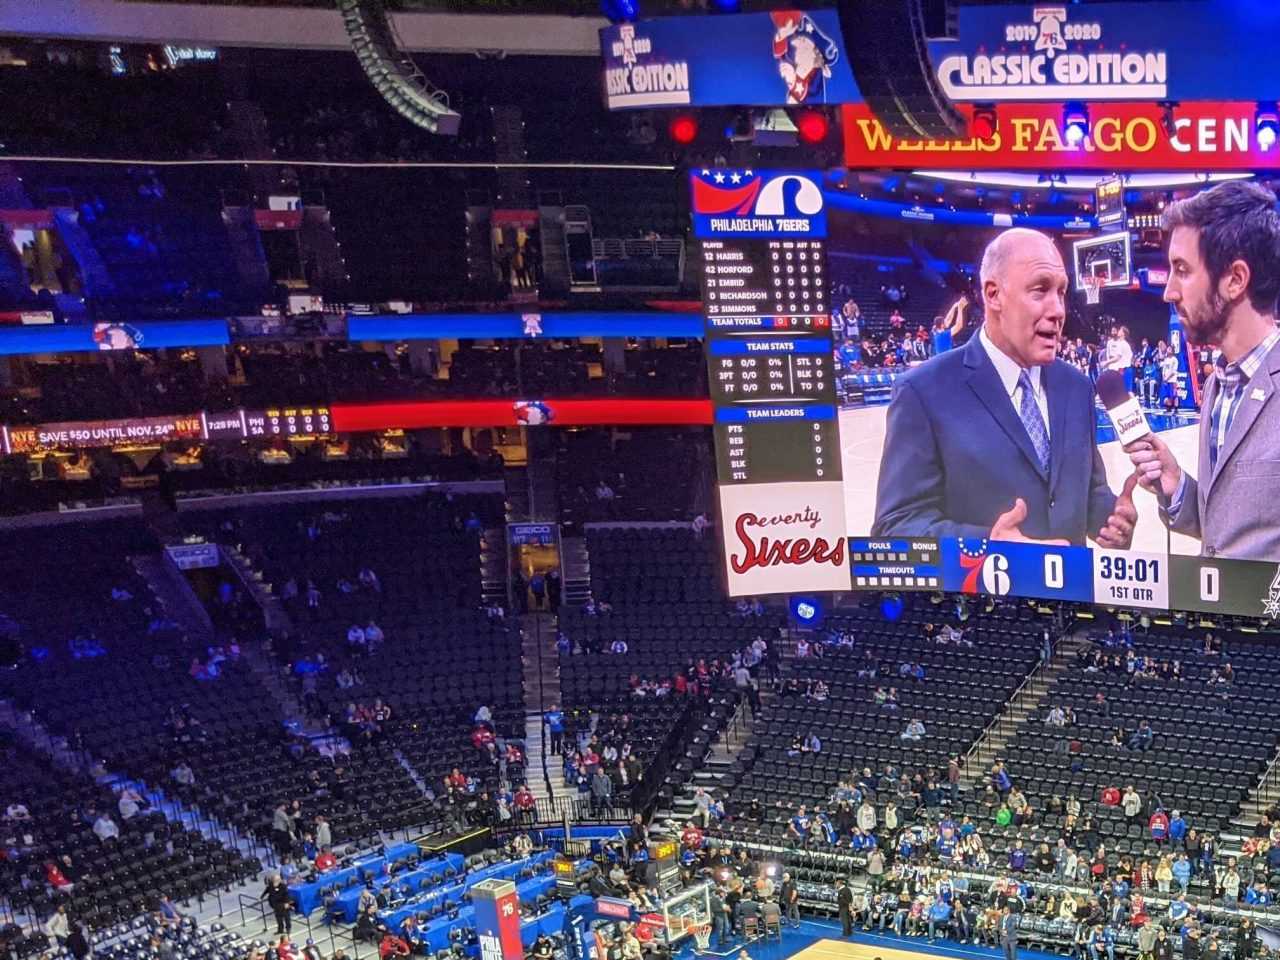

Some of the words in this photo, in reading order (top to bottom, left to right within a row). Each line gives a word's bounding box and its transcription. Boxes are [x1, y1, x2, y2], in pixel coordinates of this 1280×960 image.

[1006, 25, 1038, 41] 2019
[1065, 24, 1101, 40] 2020
[1042, 32, 1058, 45] 76
[938, 54, 1047, 88] CLASSIC
[1053, 52, 1168, 85] EDITION
[632, 62, 689, 92] EDITION
[711, 219, 774, 232] PHILADELPHIA
[776, 219, 810, 232] 76ERS
[704, 253, 714, 261] 12
[716, 252, 744, 261] HARRIS
[706, 266, 716, 274] 42
[717, 266, 753, 274] HORFORD
[707, 279, 716, 287] 21
[720, 292, 767, 300] RICHARDSON
[709, 305, 719, 313] 25
[721, 305, 757, 313] SIMMONS
[712, 318, 734, 326] TEAM
[746, 343, 770, 351] TEAM
[770, 342, 794, 350] STATS
[722, 360, 733, 368] FG
[741, 359, 756, 367] 0/0
[768, 358, 782, 367] 0%
[797, 358, 811, 366] STL
[719, 372, 735, 380] 3PT
[742, 371, 757, 380] 0/0
[769, 370, 782, 379] 0%
[797, 370, 812, 378] BLK
[742, 383, 758, 392] 0/0
[770, 383, 784, 391] 0%
[801, 382, 812, 390] TO
[747, 410, 770, 418] TEAM
[770, 409, 805, 417] LEADERS
[249, 417, 264, 427] PHI
[10, 430, 35, 444] NYE
[39, 431, 69, 443] SAVE
[70, 429, 90, 441] $50
[93, 427, 126, 440] UNTIL
[128, 424, 154, 438] NOV.
[155, 424, 175, 436] 24th
[176, 419, 200, 432] NYE
[208, 420, 226, 430] 7:28
[227, 419, 240, 429] PM
[252, 426, 264, 435] SA
[728, 425, 743, 433] PTS
[729, 437, 744, 445] REB
[731, 460, 746, 468] BLK
[733, 472, 747, 480] STL
[868, 542, 891, 550] FOULS
[912, 542, 938, 550] BONUS
[730, 535, 845, 575] Sixers
[878, 566, 916, 574] TIMEOUTS
[959, 552, 1011, 596] 76
[1044, 554, 1064, 589] 0
[1100, 556, 1160, 583] 39:01
[1200, 567, 1219, 601] 0
[1110, 586, 1128, 599] 1ST
[1133, 587, 1153, 601] QTR
[480, 935, 501, 953] PHILA
